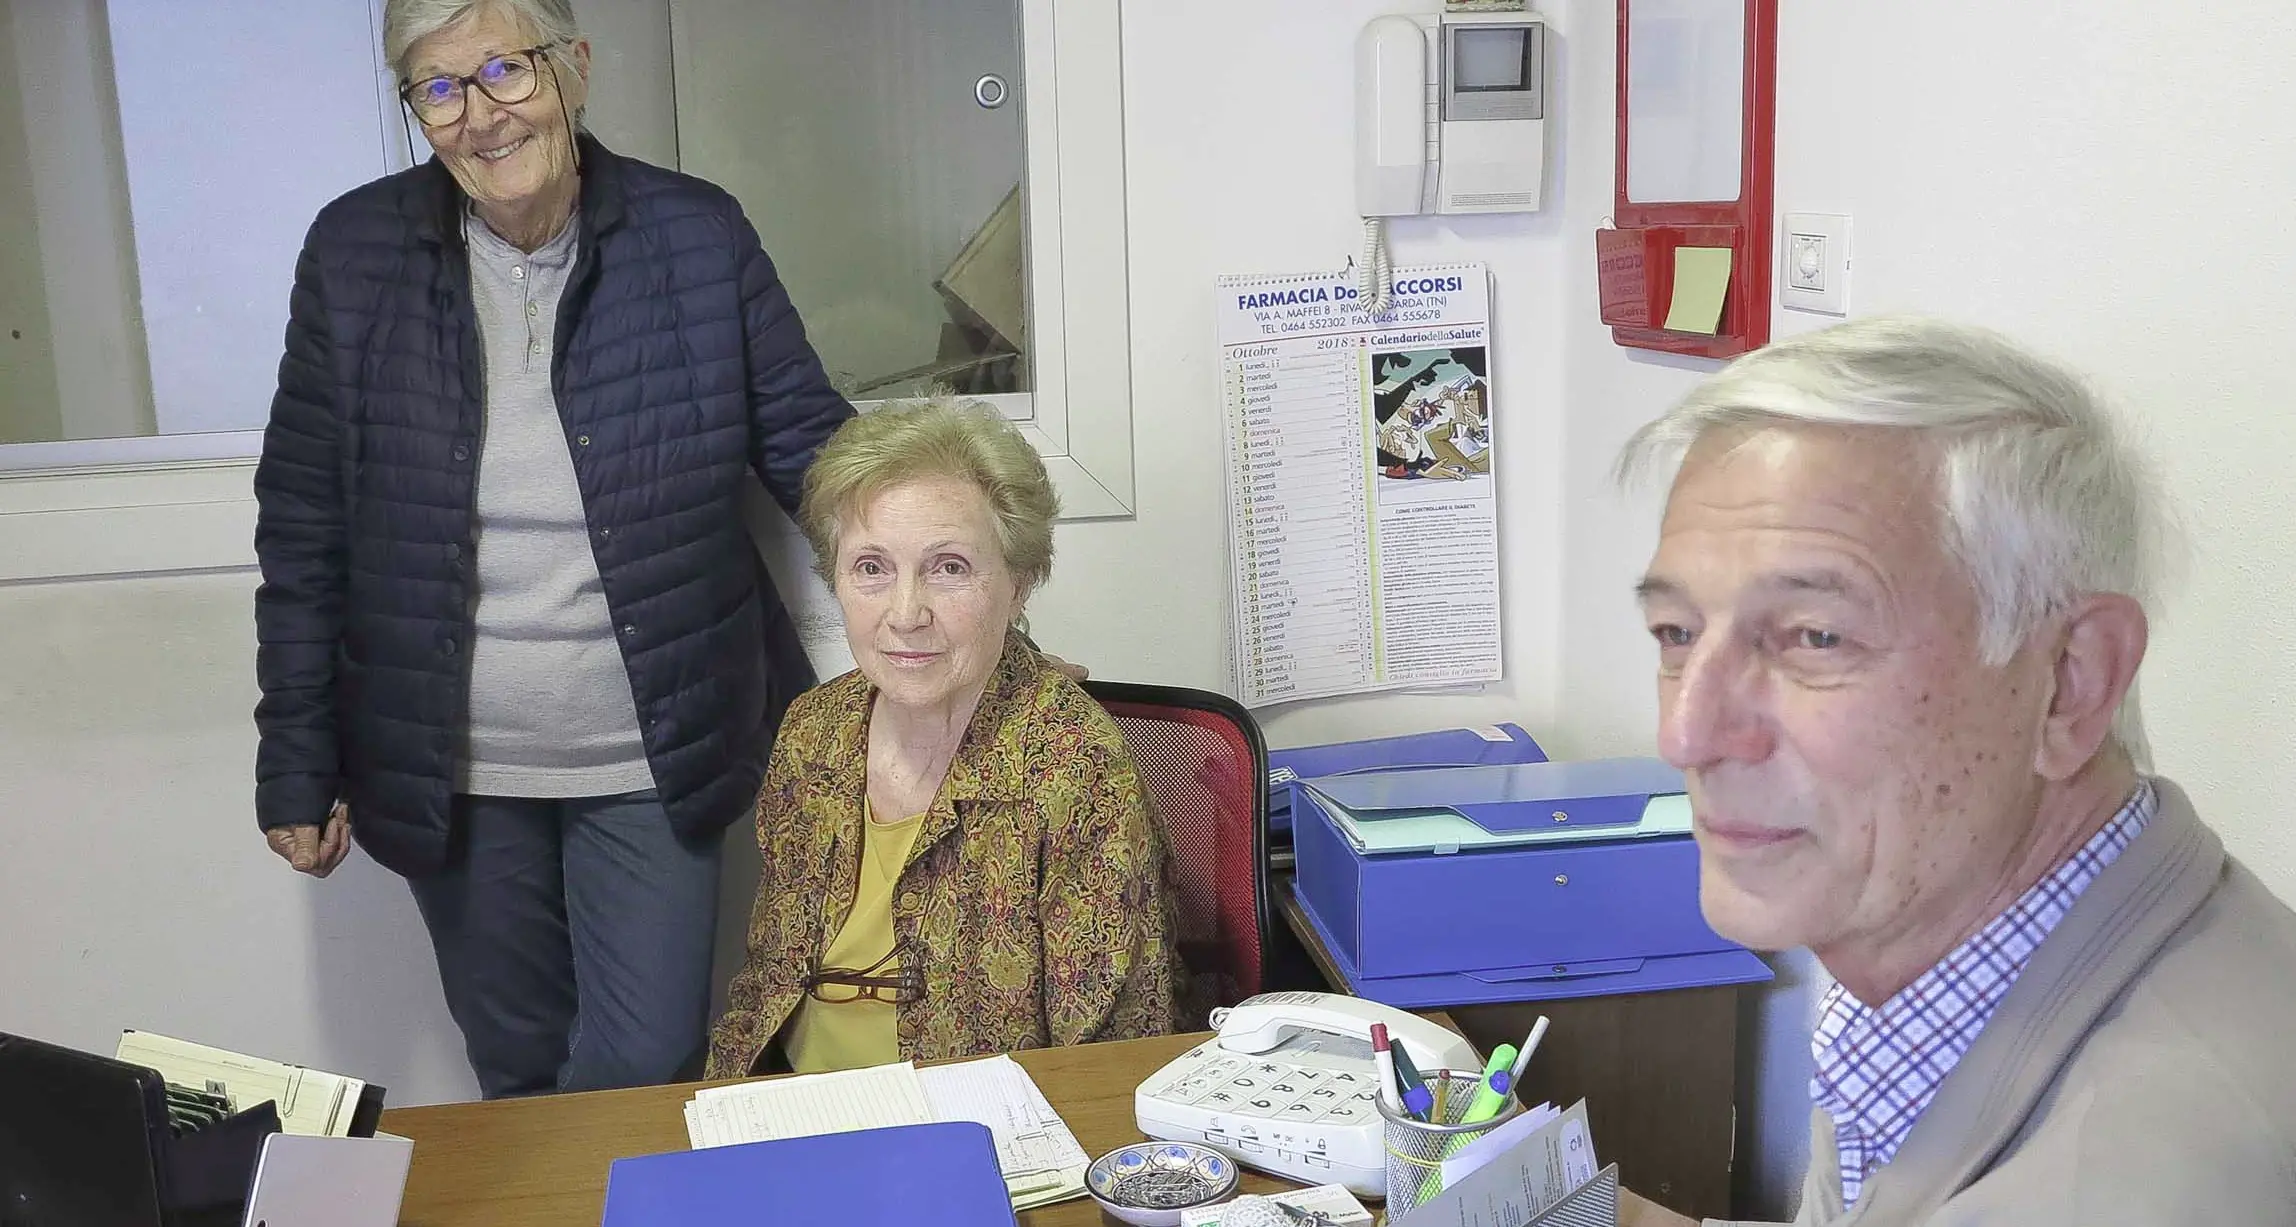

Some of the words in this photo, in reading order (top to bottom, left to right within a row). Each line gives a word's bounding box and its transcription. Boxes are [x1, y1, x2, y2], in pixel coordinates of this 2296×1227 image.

[1238, 286, 1328, 310] FARMACIA
[1254, 311, 1271, 322] VIA
[1273, 310, 1284, 320] A.
[1286, 306, 1321, 319] MAFFEI
[1324, 304, 1331, 315] 8
[1340, 303, 1363, 314] RIVA
[1426, 296, 1448, 308] (TN)
[1281, 321, 1306, 333] 0464
[1308, 317, 1346, 330] 552302
[1351, 314, 1371, 326] FAX
[1373, 313, 1399, 324] 0464
[1402, 309, 1441, 321] 555678
[1371, 329, 1482, 346] CalendariodellaSalute
[1232, 345, 1279, 359] Ottobre
[1316, 337, 1349, 350] 2018
[1239, 363, 1243, 371] 1
[1239, 374, 1244, 382] 2
[1240, 386, 1245, 394] 3
[1240, 397, 1246, 405] 4
[1241, 408, 1246, 416] 5
[1242, 419, 1247, 427] 6
[1242, 430, 1247, 438] 7
[1243, 441, 1249, 449] 8
[1244, 452, 1249, 460] 9
[1241, 463, 1250, 471] 10
[1242, 475, 1250, 483] 11
[1243, 486, 1251, 494] 12
[1244, 496, 1252, 504] 13
[1244, 507, 1253, 515] 14
[1245, 518, 1253, 526] 15
[1246, 529, 1254, 537] 16
[1247, 540, 1255, 548] 17
[1248, 551, 1256, 559] 18
[1248, 562, 1257, 570] 19
[1248, 572, 1257, 581] 20
[1249, 583, 1258, 591] 21
[1250, 594, 1259, 602] 22
[1250, 604, 1259, 613] 23
[1251, 615, 1260, 624] 24
[1251, 625, 1260, 634] 25
[1252, 636, 1261, 645] 26
[1253, 646, 1262, 655] 27
[1254, 657, 1263, 666] 28
[1255, 668, 1263, 677] 29
[1255, 678, 1264, 687] 30
[1255, 689, 1264, 698] 31
